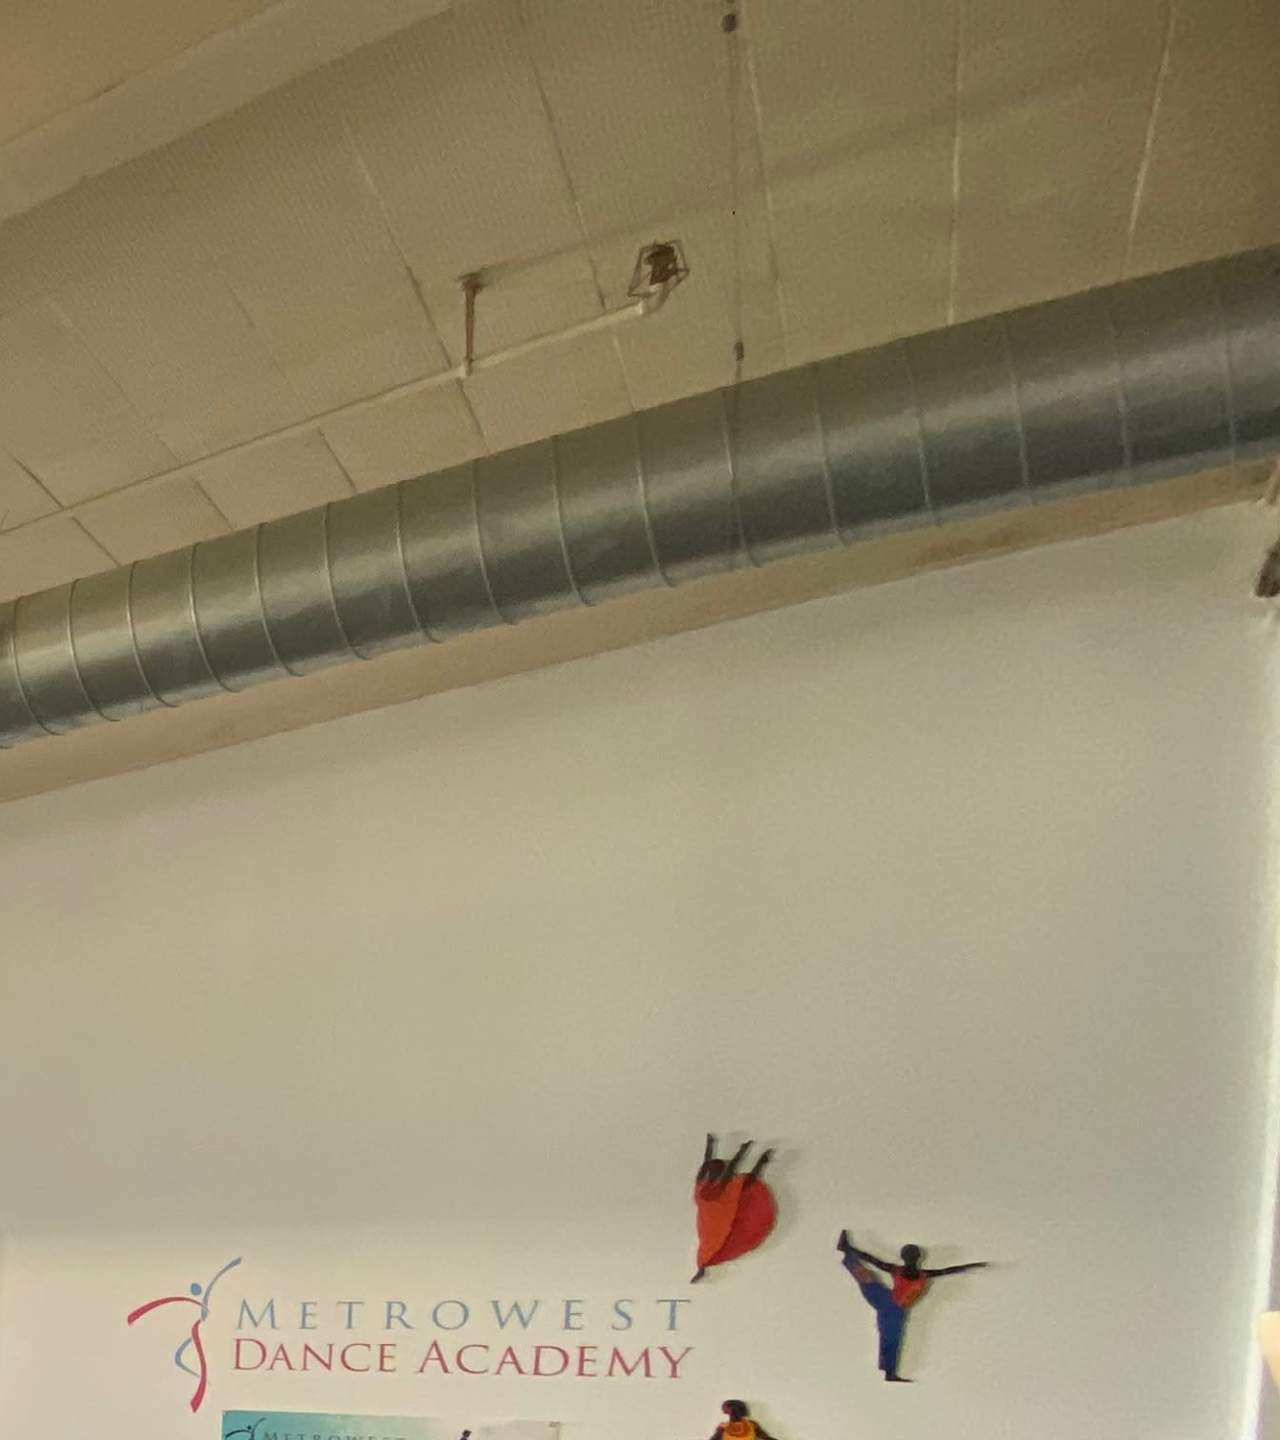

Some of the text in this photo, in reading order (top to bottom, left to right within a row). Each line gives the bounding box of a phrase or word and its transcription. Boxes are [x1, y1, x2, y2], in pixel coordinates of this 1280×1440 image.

[235, 1298, 691, 1331] METROWEST
[233, 1338, 694, 1379] DANCE ACADEMY
